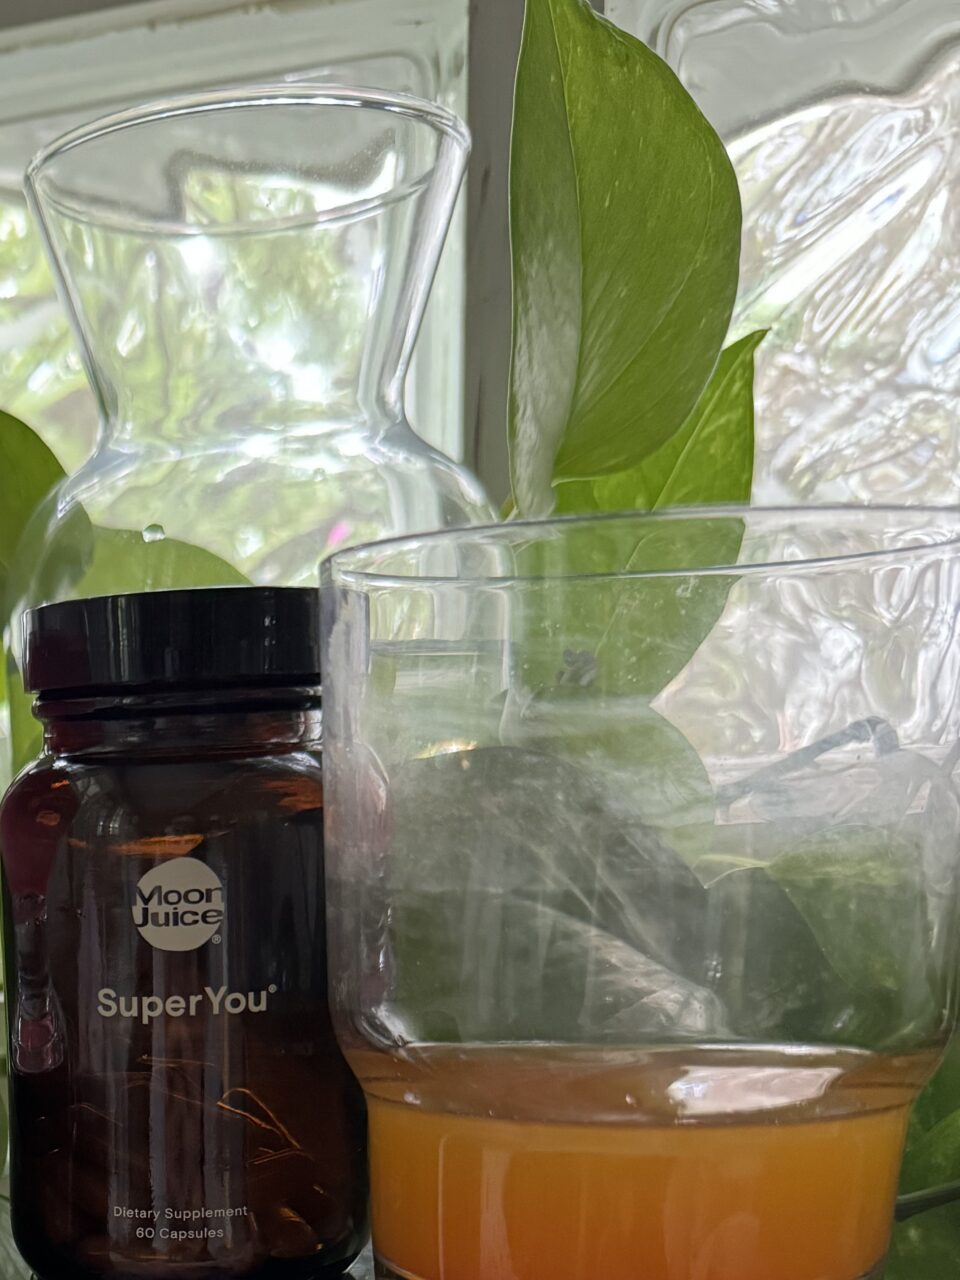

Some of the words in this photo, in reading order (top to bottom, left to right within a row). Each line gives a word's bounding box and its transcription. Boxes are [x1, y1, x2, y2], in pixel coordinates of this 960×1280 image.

[134, 885, 224, 906] Moon
[133, 907, 224, 928] Juice
[113, 1206, 160, 1221] Dietary
[164, 1205, 248, 1221] Supplement
[135, 1227, 155, 1239] 60
[160, 1227, 224, 1241] Capsules
